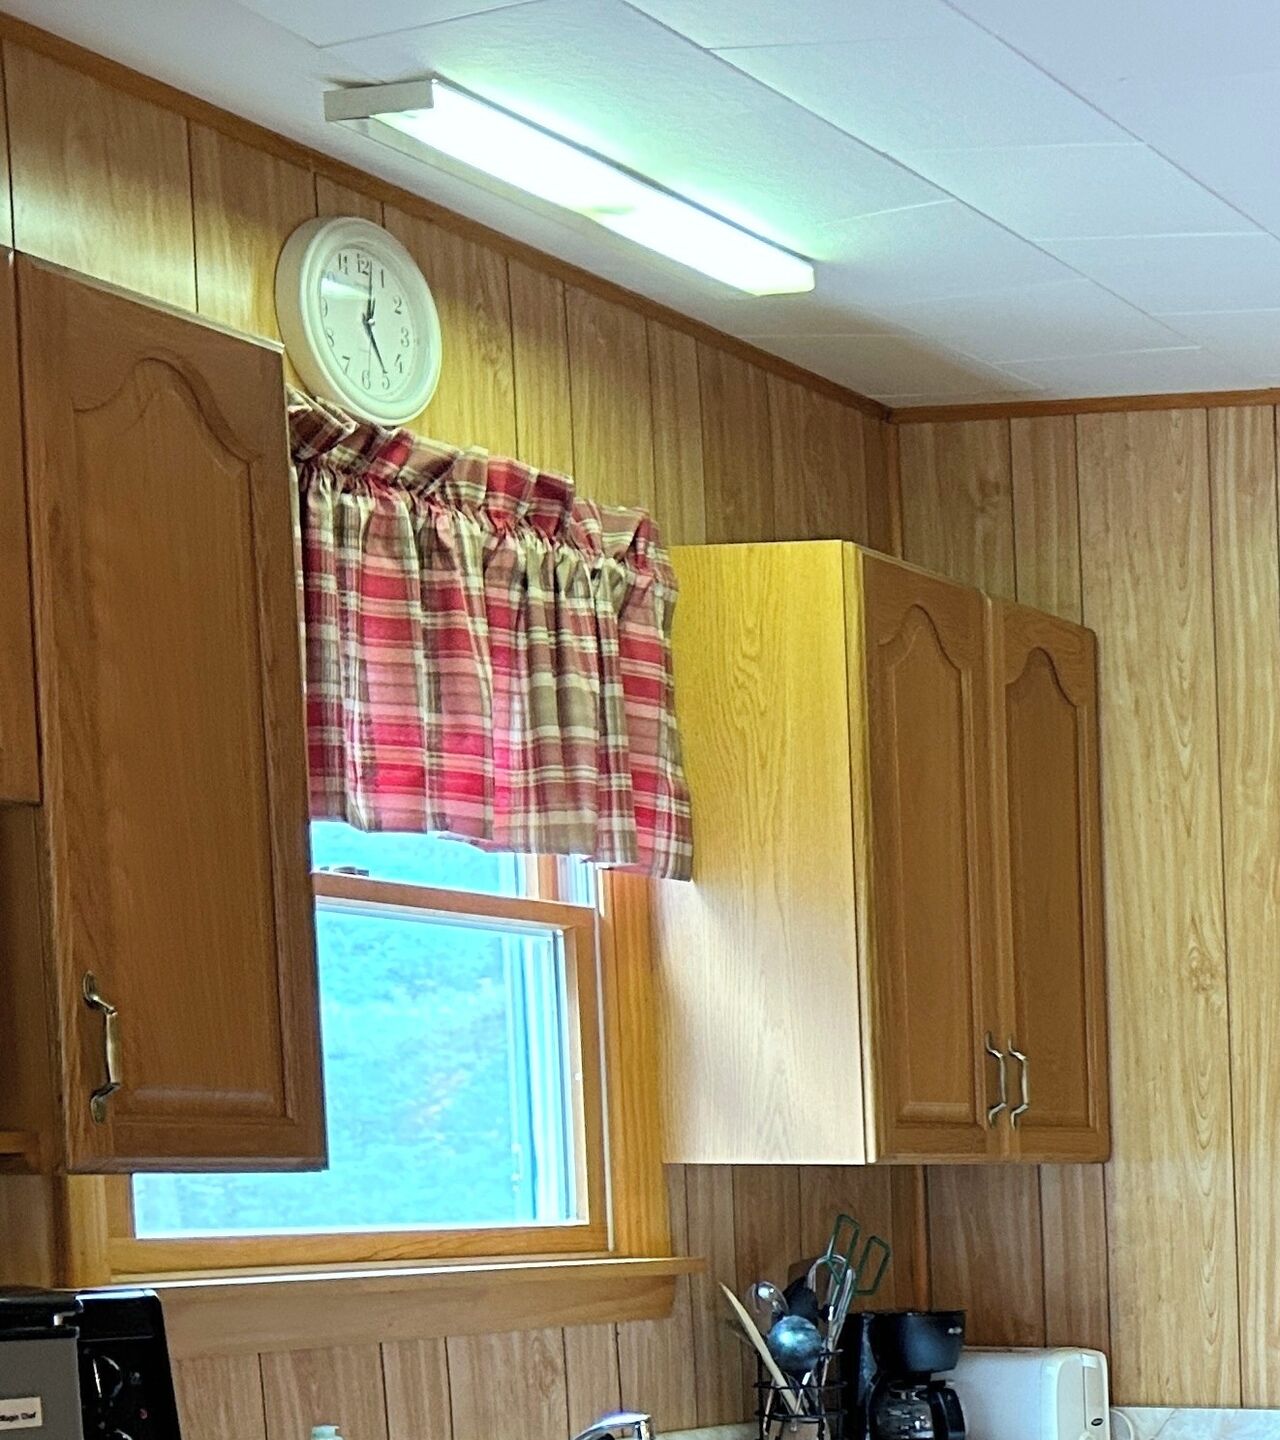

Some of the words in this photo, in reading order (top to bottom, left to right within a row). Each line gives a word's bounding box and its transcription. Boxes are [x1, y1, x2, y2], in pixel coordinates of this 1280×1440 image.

[357, 253, 369, 276] 12
[393, 296, 402, 315] 2
[400, 326, 410, 348] 3
[341, 355, 351, 375] 7
[394, 353, 403, 374] 4
[361, 369, 371, 390] 6
